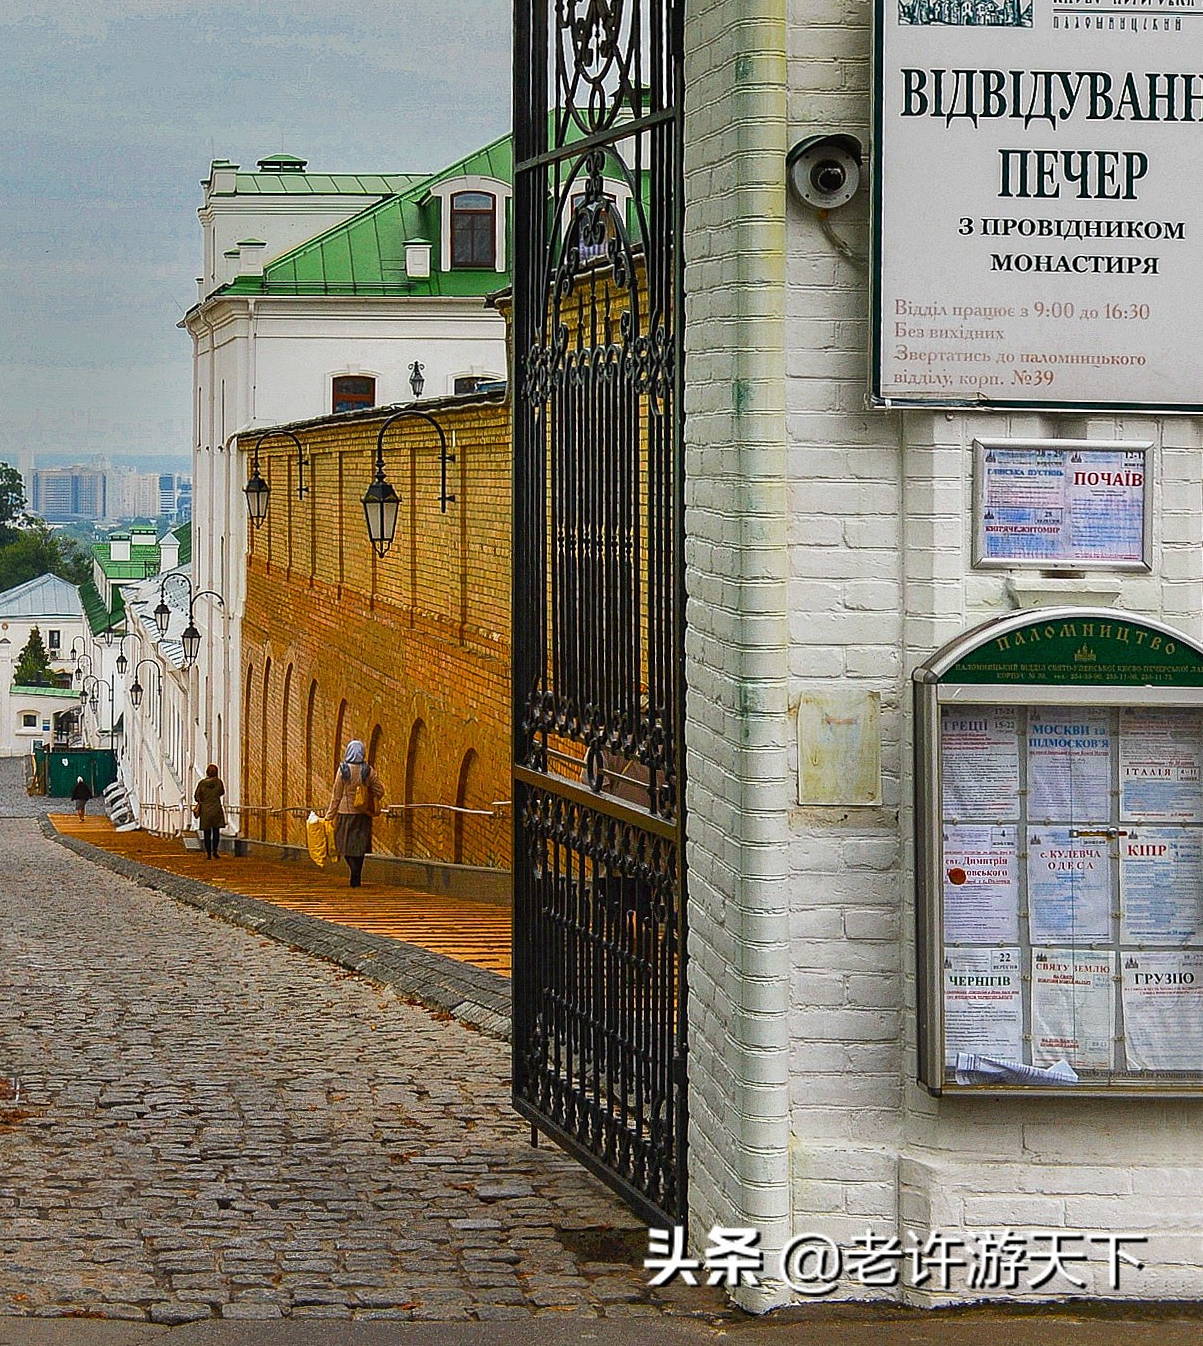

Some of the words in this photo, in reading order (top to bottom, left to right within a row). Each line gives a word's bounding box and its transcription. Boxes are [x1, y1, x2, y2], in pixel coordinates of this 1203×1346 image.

[998, 148, 1149, 200] ПЕЧЕР
[958, 217, 974, 236] З
[980, 217, 1186, 241] ПРОВІДНИКОМ
[990, 253, 1160, 275] МОНАСТИРЯ
[895, 299, 948, 320] Відділ
[953, 306, 1016, 320] працює
[1020, 306, 1029, 317] з
[1034, 301, 1074, 318] 9:00
[1079, 307, 1099, 320] до
[1105, 303, 1150, 320] 16:30
[894, 322, 925, 338] Без
[930, 324, 1005, 340] вихідних
[894, 344, 991, 365] Звертатись
[996, 352, 1015, 363] до
[1020, 353, 1146, 368] паломницького
[894, 369, 953, 388] відділу,
[959, 374, 1004, 388] корп.
[1010, 369, 1054, 386] №39
[1074, 470, 1143, 487] ПОЧАЇВ
[997, 623, 1176, 655] ПАЛОМНИЦТВО
[1032, 724, 1089, 735] МОСКВИ
[1126, 768, 1171, 776] ІТАЛІЯ
[1127, 844, 1167, 856] КІПР
[1048, 862, 1094, 870] ОДЕСА
[999, 953, 1011, 962] 22
[949, 976, 1011, 987] ЧЕРНІГІВ
